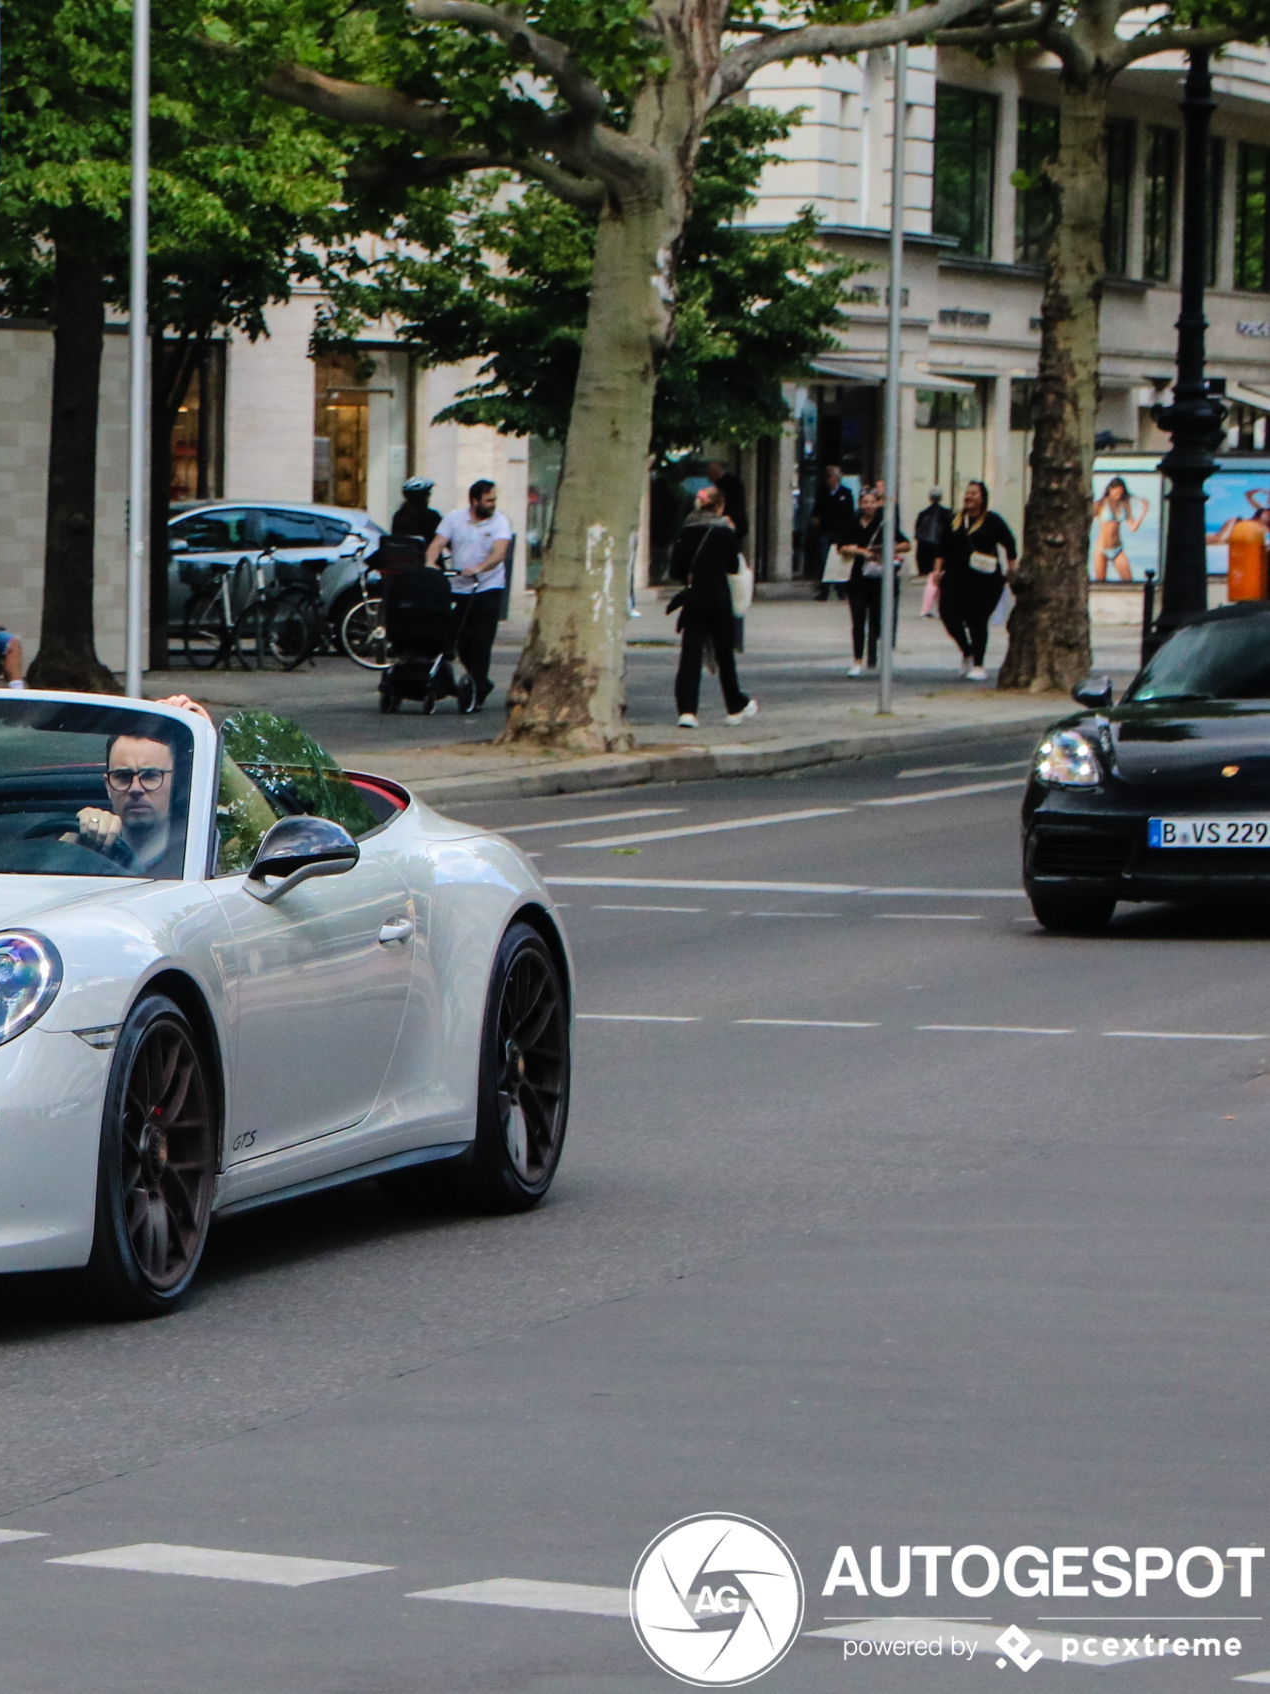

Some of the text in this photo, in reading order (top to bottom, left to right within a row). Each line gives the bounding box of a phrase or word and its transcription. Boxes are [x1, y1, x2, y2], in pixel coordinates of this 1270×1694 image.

[1163, 823, 1176, 843] B
[1192, 823, 1220, 843] VS
[1227, 823, 1270, 843] 229
[232, 1129, 257, 1151] GTS
